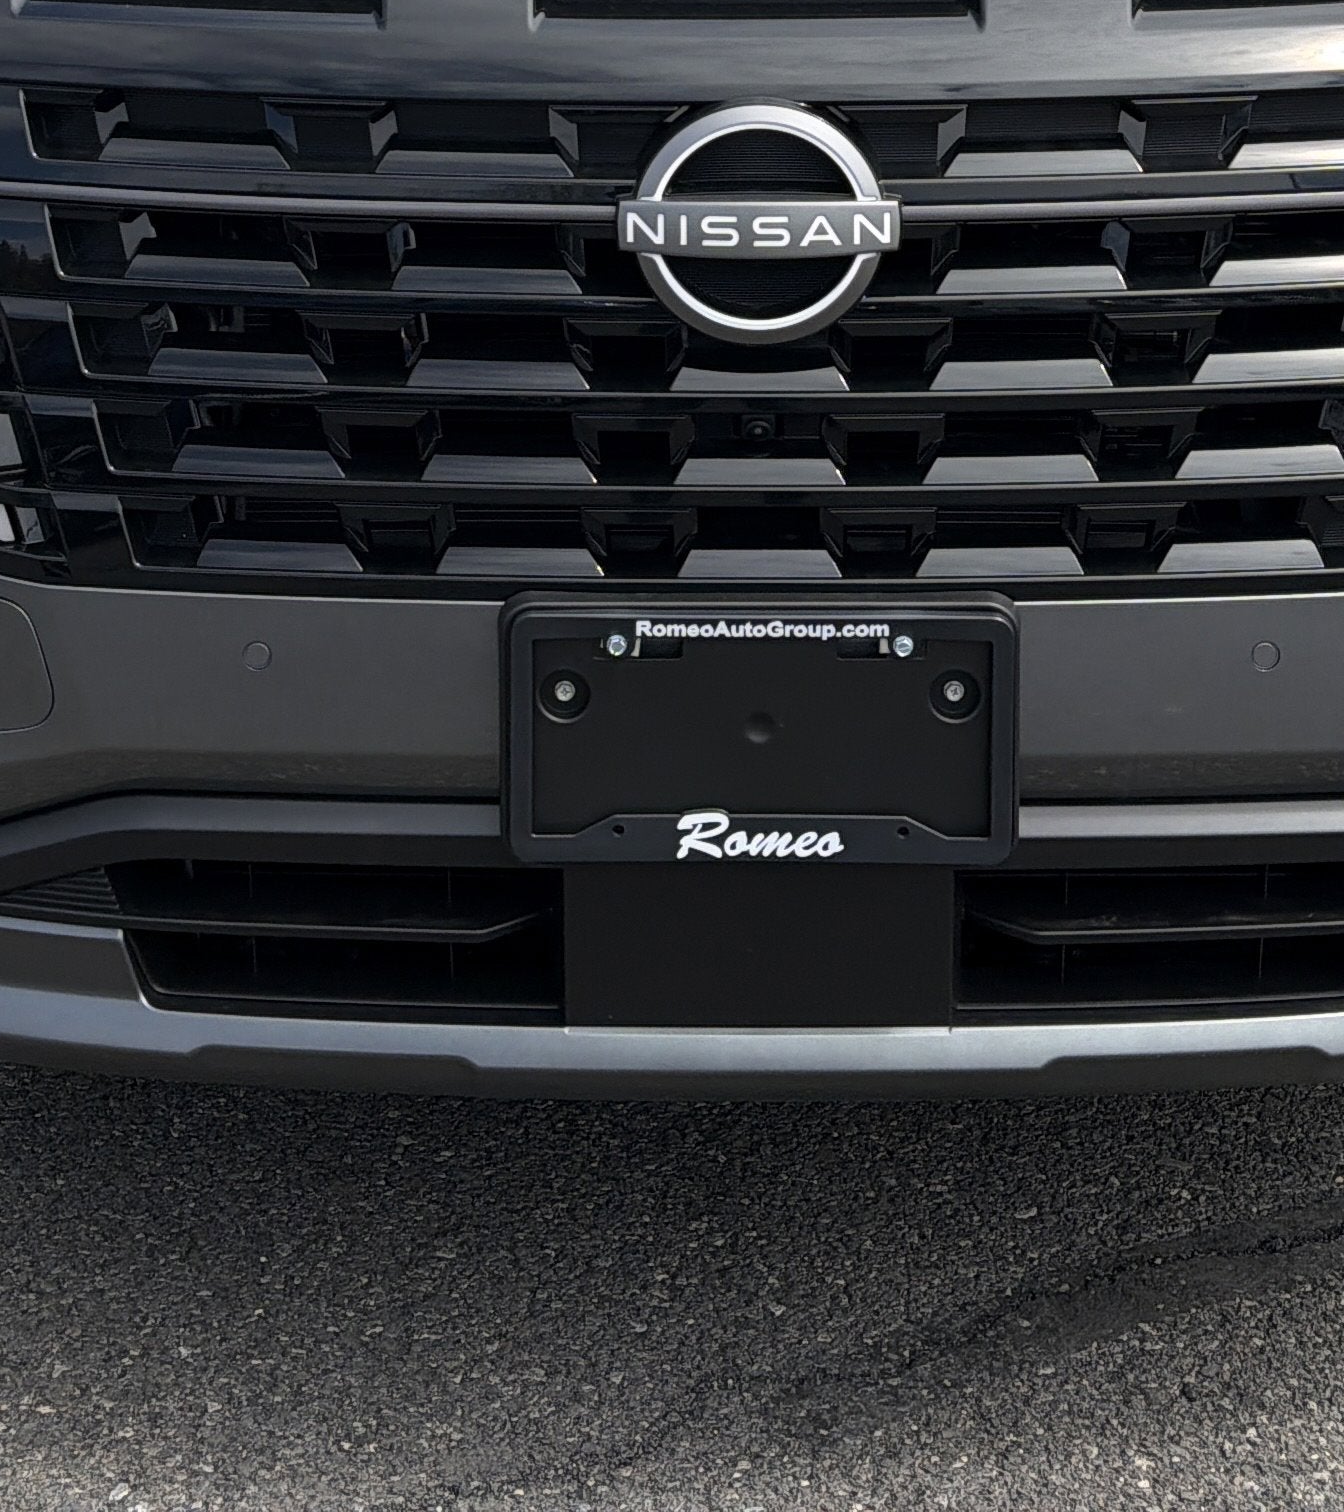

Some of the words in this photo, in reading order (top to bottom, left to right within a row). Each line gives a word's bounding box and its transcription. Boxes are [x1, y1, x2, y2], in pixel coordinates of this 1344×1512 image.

[625, 211, 892, 248] NISSAN
[635, 620, 890, 640] RomeoAutoGroup.com
[676, 811, 845, 860] Romeo
